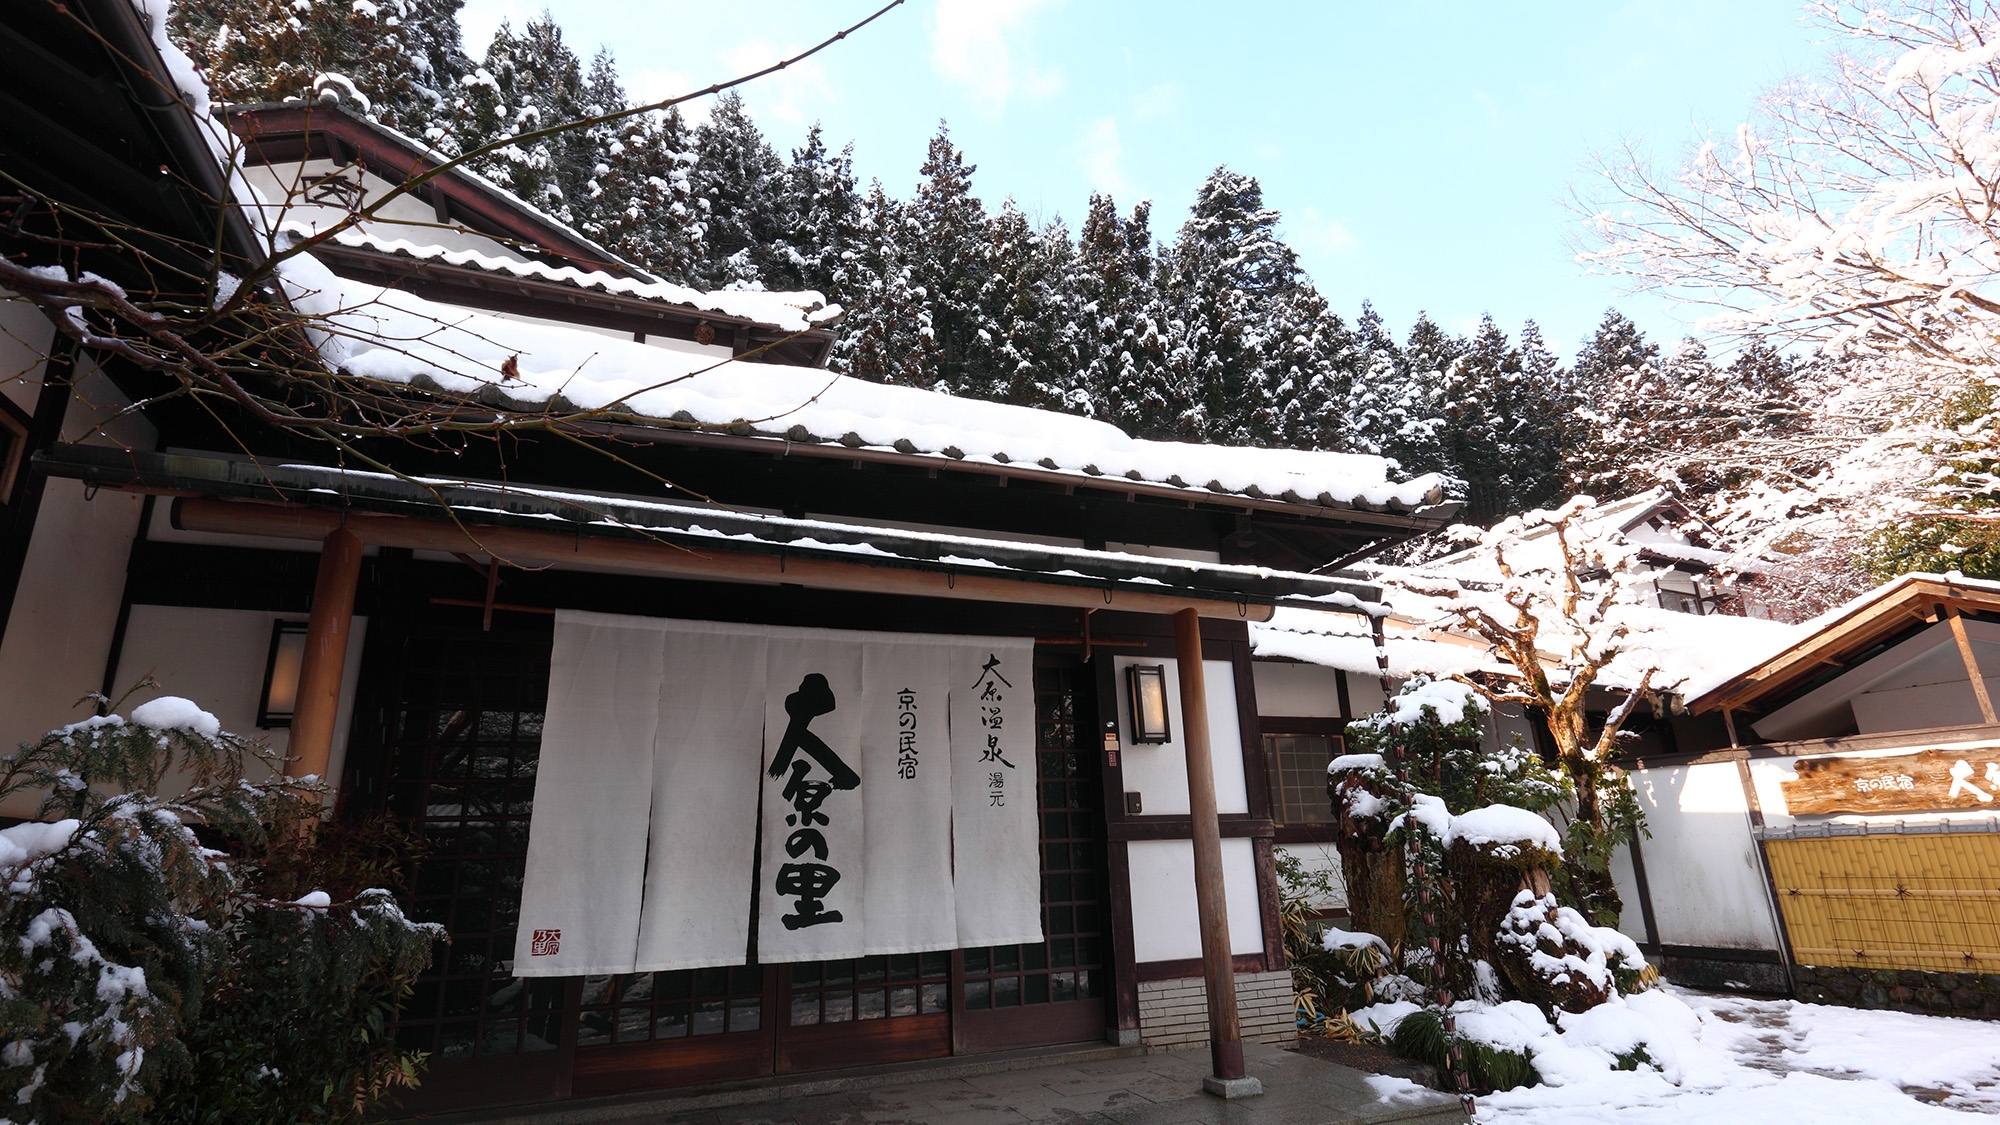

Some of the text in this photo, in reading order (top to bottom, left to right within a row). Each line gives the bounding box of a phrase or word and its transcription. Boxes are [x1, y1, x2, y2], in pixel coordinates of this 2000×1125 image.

[896, 687, 918, 780] 京の民宿
[971, 652, 1016, 807] 大原温泉 湯元
[1853, 773, 1916, 793] 京の民宿
[766, 672, 861, 931] 大原の里
